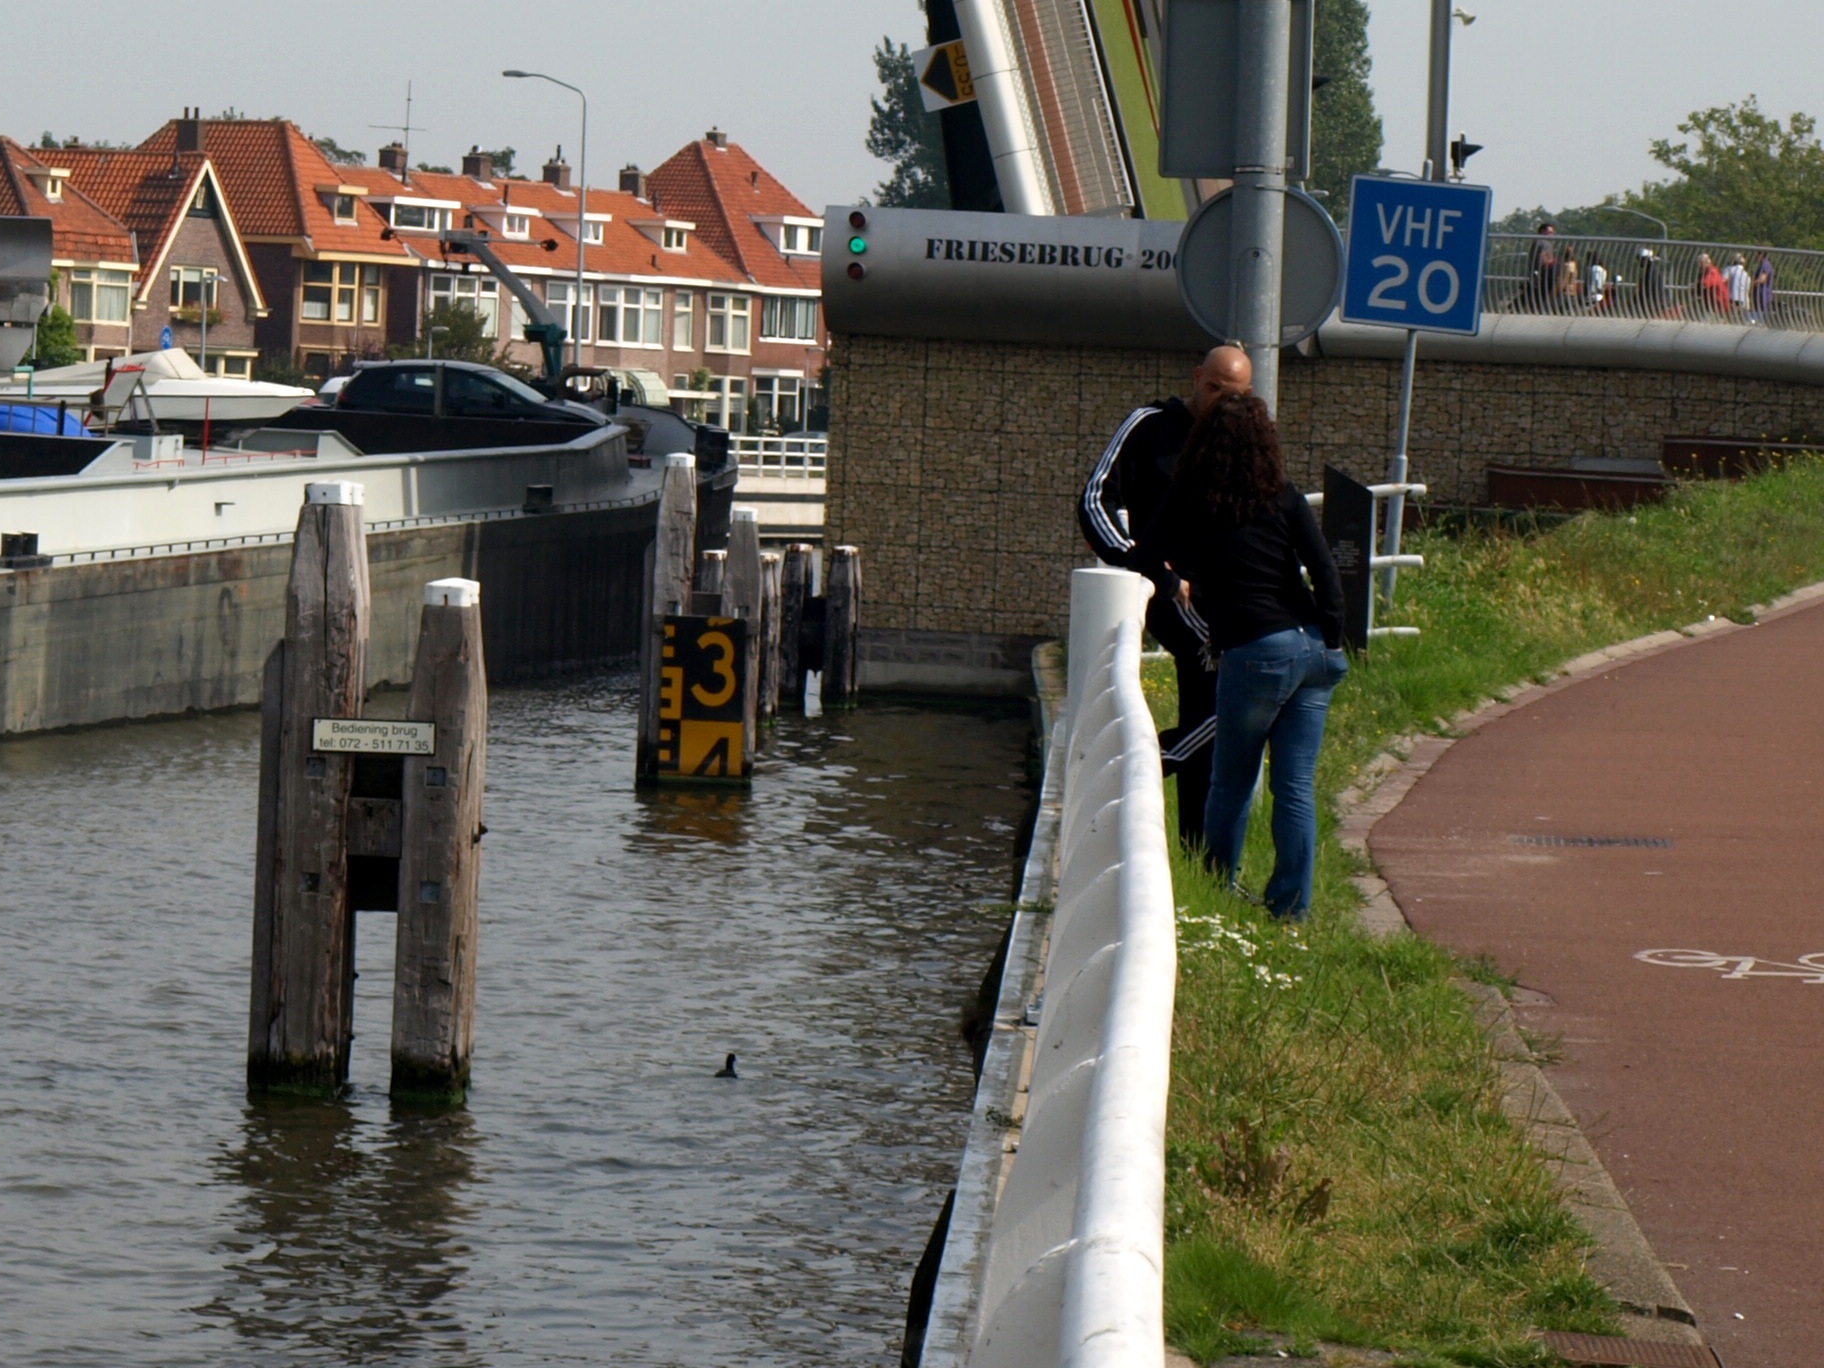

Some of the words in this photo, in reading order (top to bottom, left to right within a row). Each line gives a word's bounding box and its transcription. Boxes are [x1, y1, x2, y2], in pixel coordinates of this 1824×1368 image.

[1376, 202, 1462, 249] VHF
[924, 238, 1125, 269] FRIESEBRUG
[1139, 249, 1178, 271] 20
[1367, 254, 1460, 314] 20
[690, 631, 737, 708] 3
[319, 737, 336, 749] tel:
[339, 738, 361, 749] 072
[371, 739, 393, 750] 511
[397, 740, 411, 750] 71
[414, 740, 429, 752] 35
[331, 722, 389, 737] Bediening
[391, 724, 418, 739] brug
